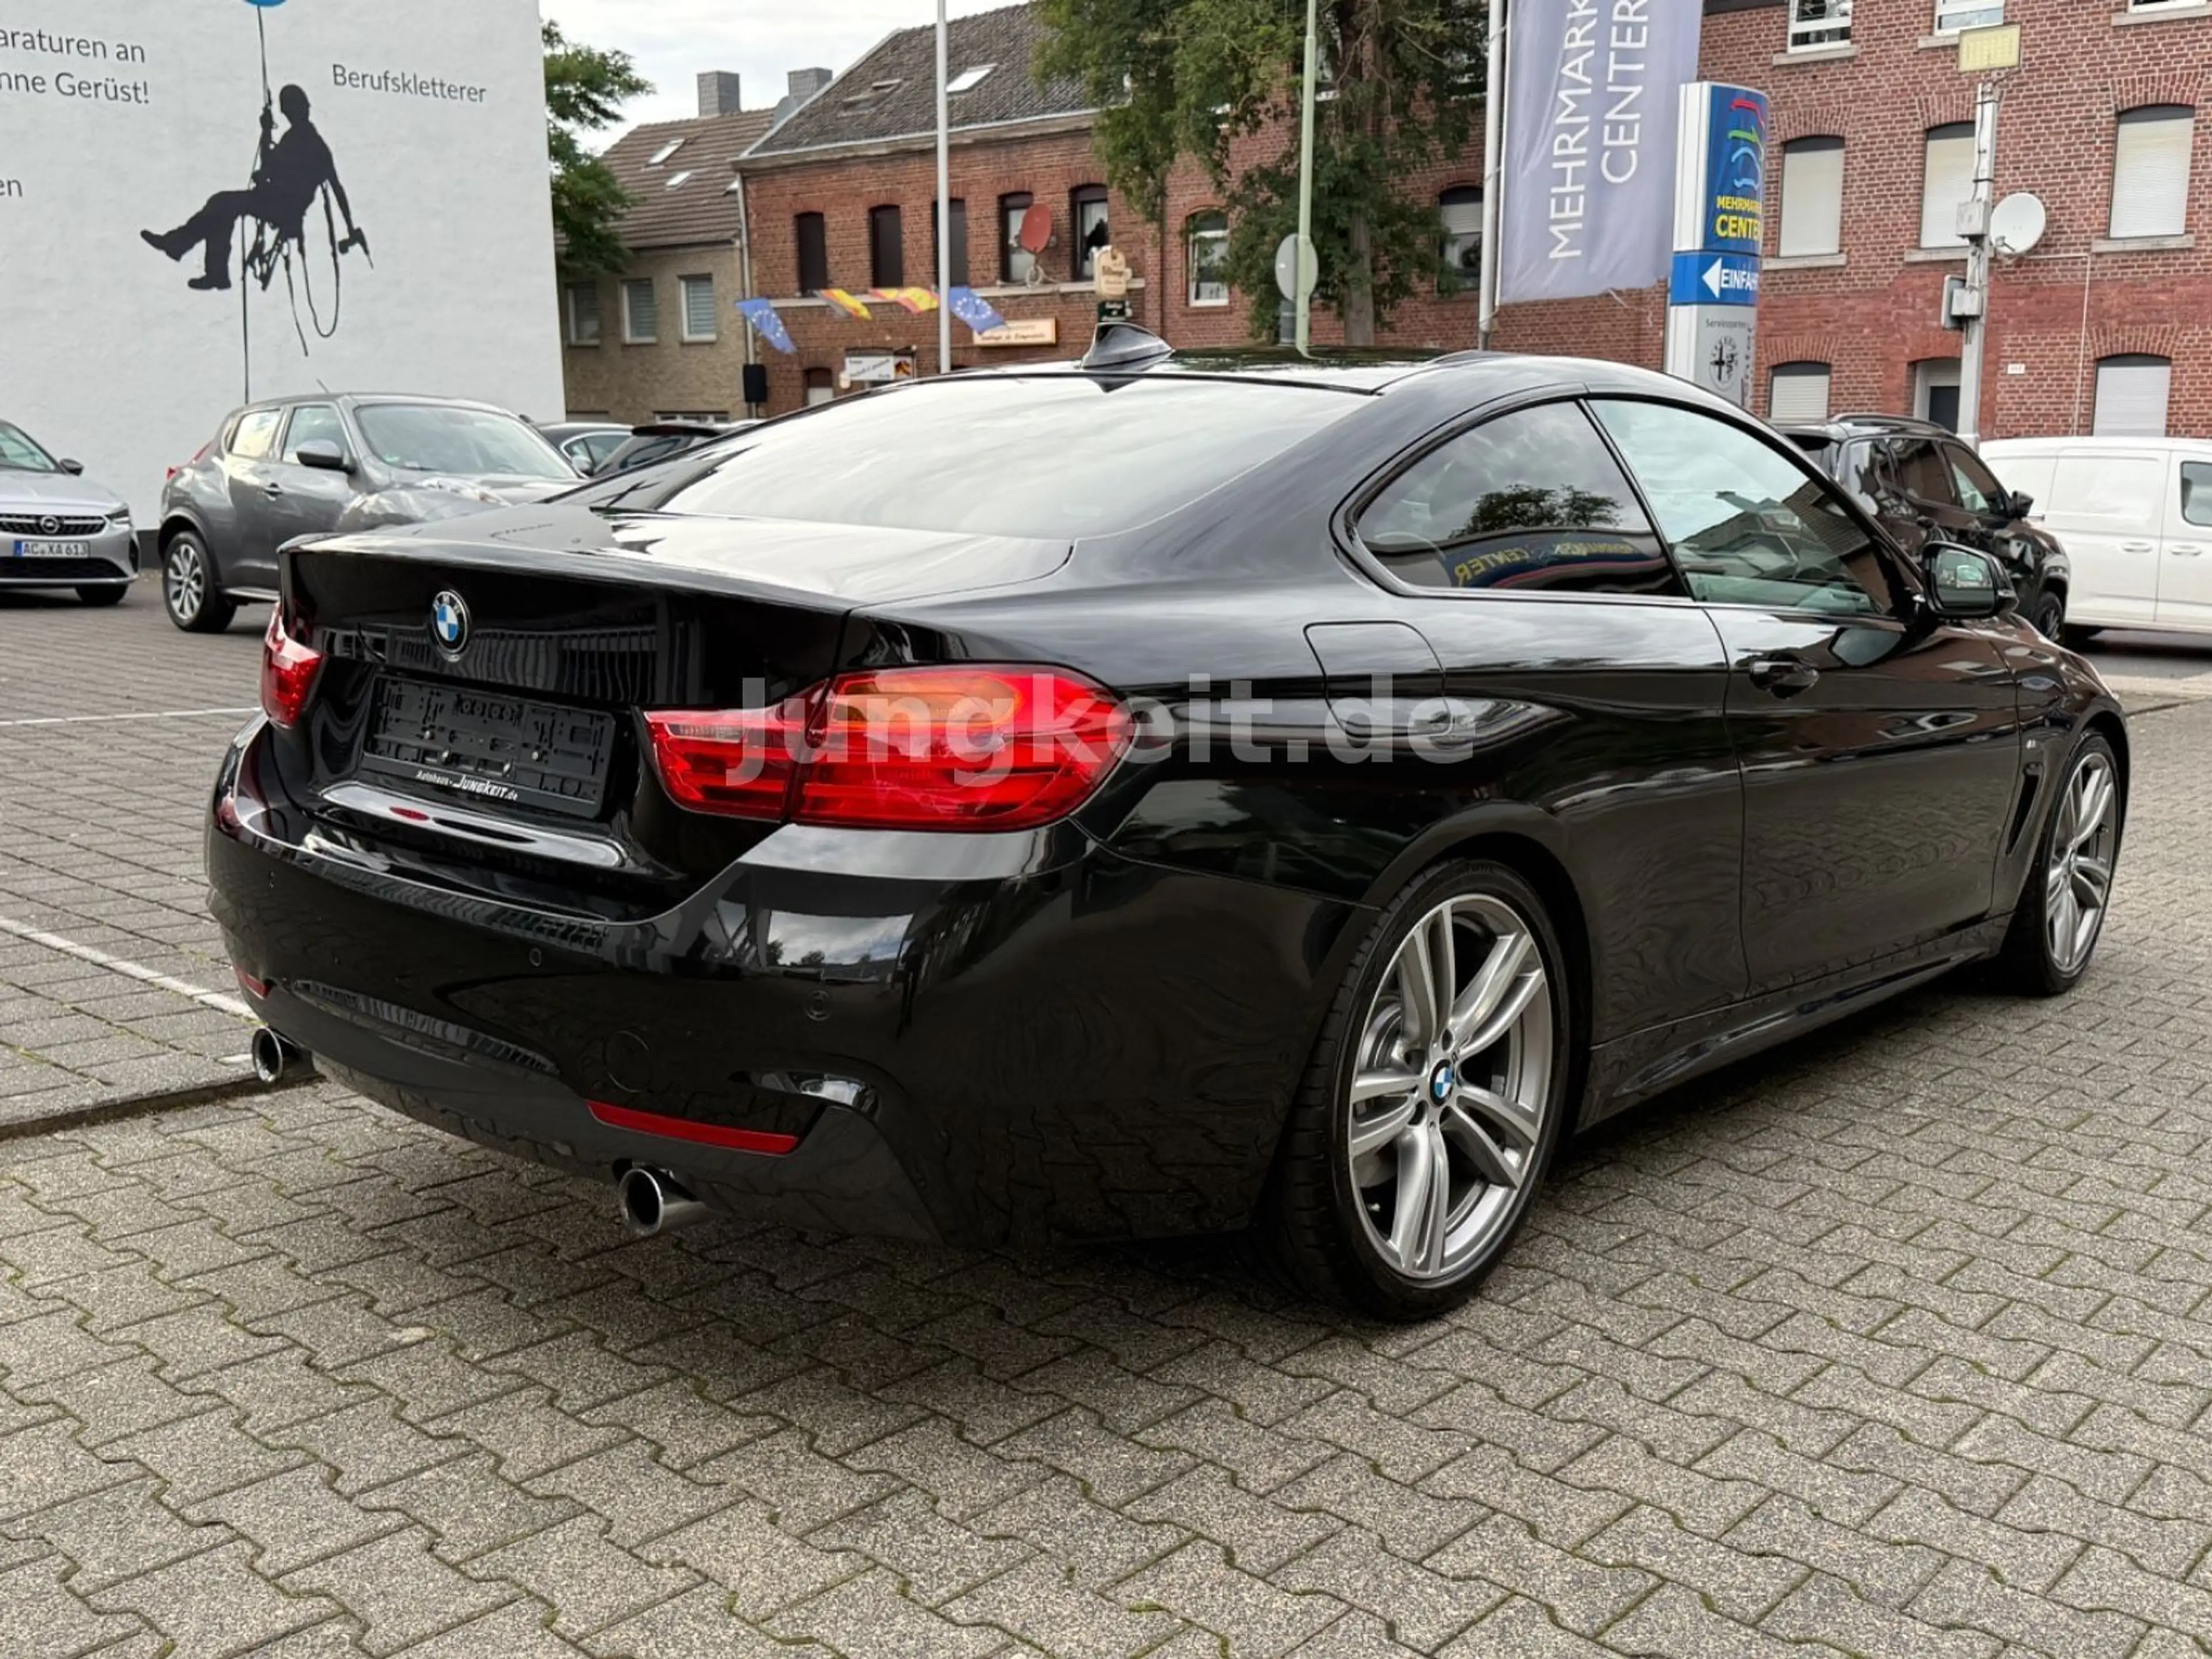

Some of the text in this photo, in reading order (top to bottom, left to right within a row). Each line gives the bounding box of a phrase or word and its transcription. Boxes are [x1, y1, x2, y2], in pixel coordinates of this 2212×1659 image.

[116, 43, 145, 64] an
[55, 72, 150, 104] Gerüst!
[332, 63, 487, 103] Berufskletterer
[1600, 0, 1649, 184] CENTER
[23, 543, 39, 555] AC
